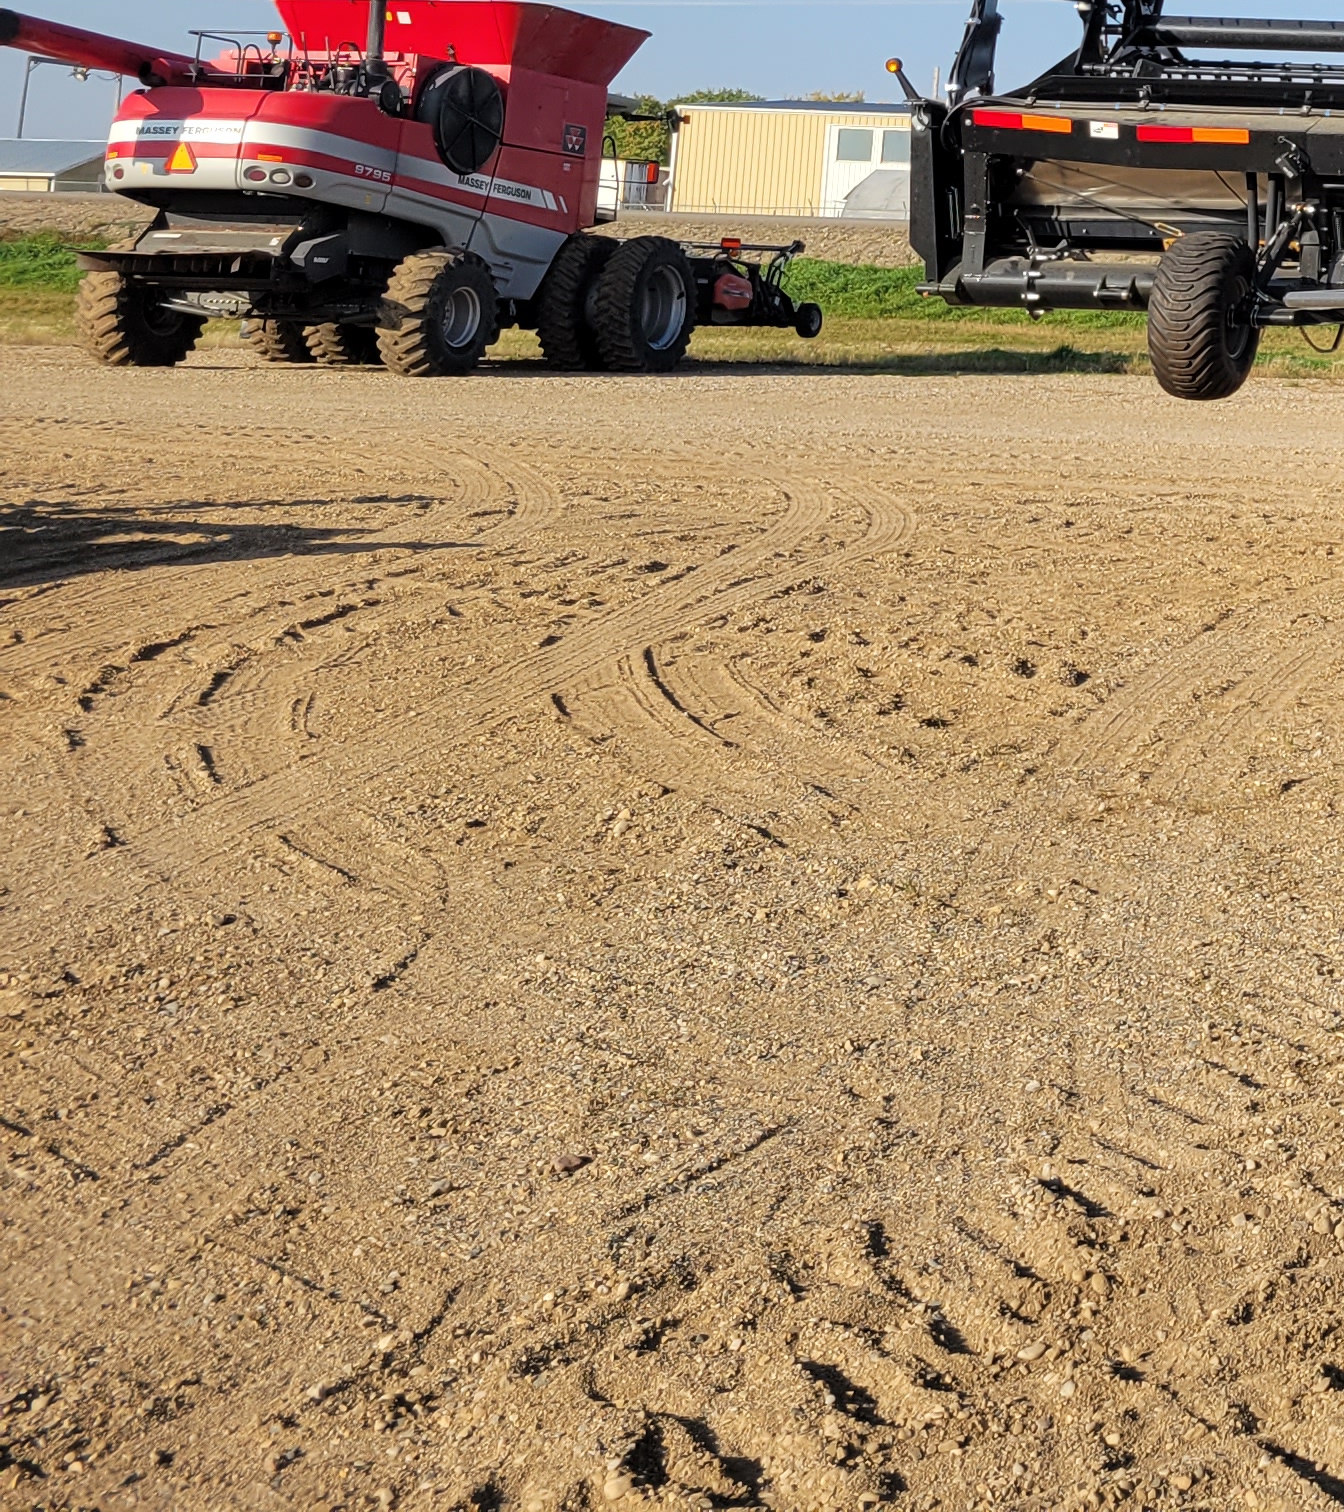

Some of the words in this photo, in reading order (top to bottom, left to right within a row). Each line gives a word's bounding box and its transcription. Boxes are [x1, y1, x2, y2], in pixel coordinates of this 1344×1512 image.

[136, 126, 179, 135] MASSEY
[355, 164, 392, 182] 9795
[458, 174, 489, 192] MASSEY
[493, 183, 532, 201] FERGUSON
